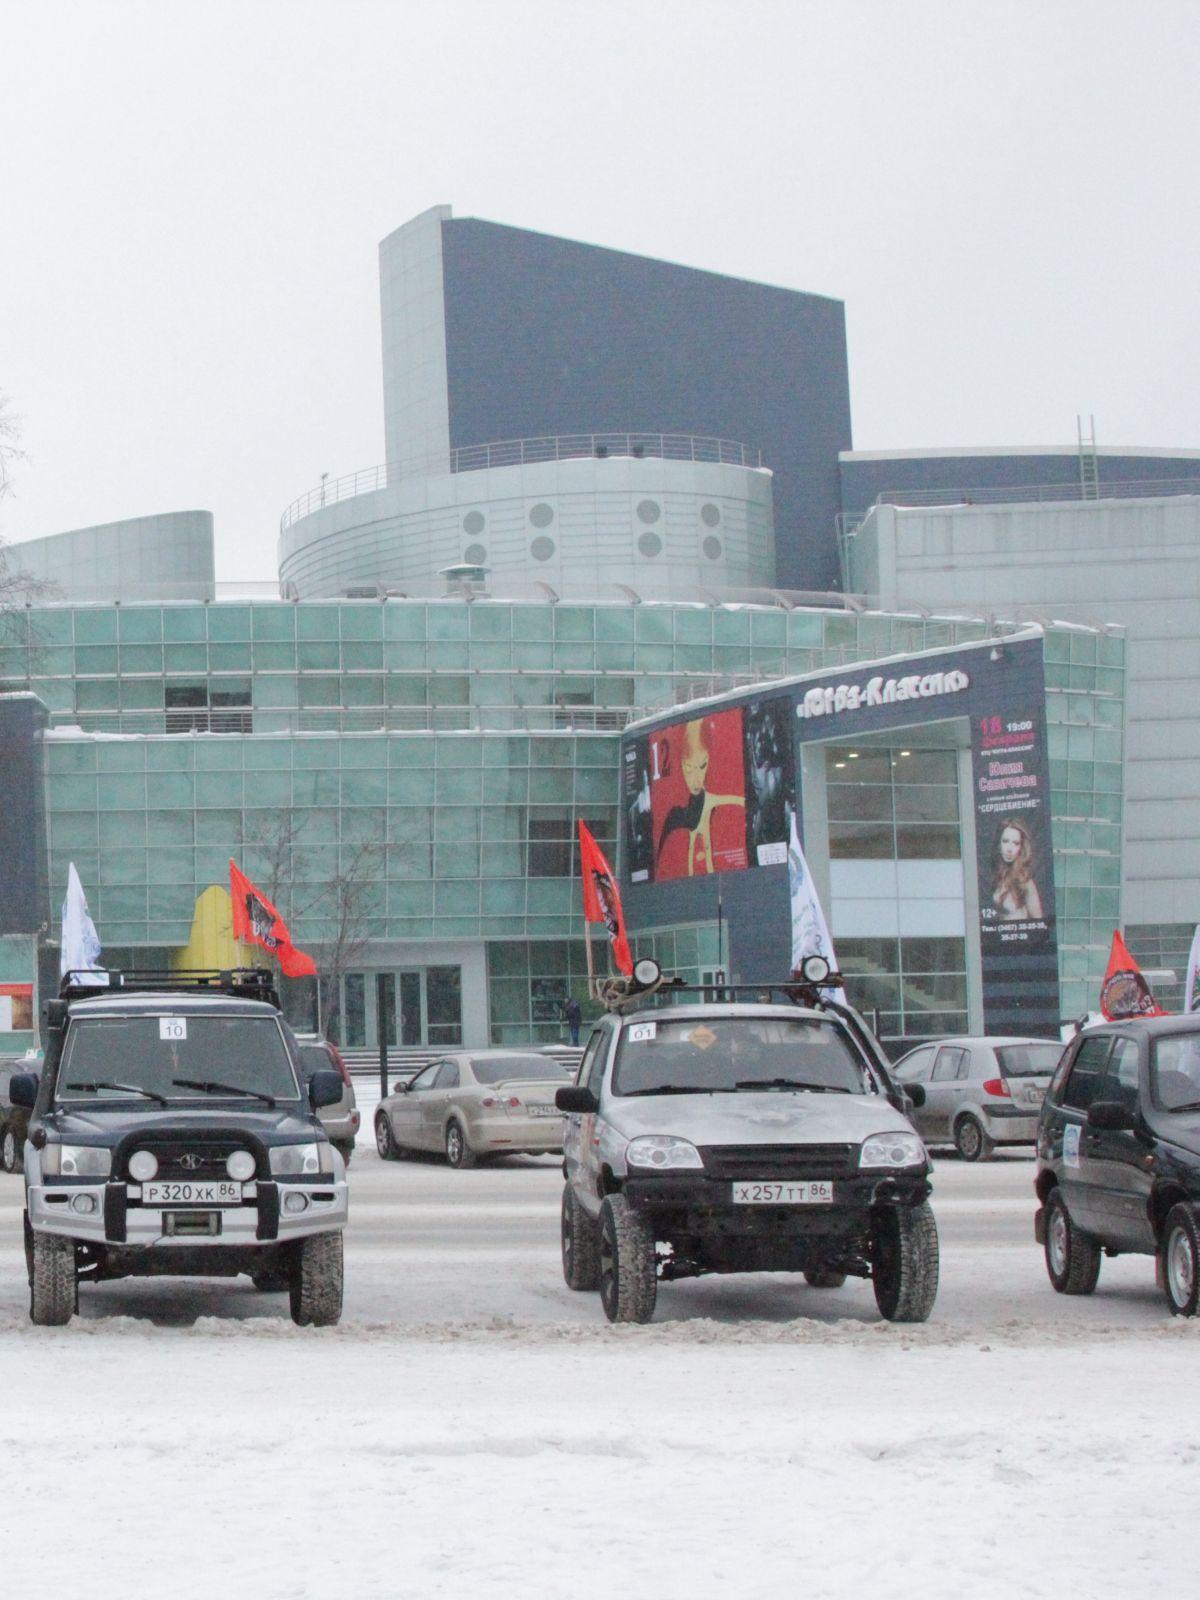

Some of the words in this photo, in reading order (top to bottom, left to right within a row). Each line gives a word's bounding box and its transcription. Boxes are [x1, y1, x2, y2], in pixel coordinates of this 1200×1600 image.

[1006, 720, 1033, 732] 19:00
[652, 738, 671, 781] 12
[981, 908, 997, 918] 12+
[165, 1025, 183, 1037] 10
[634, 1029, 651, 1039] 01
